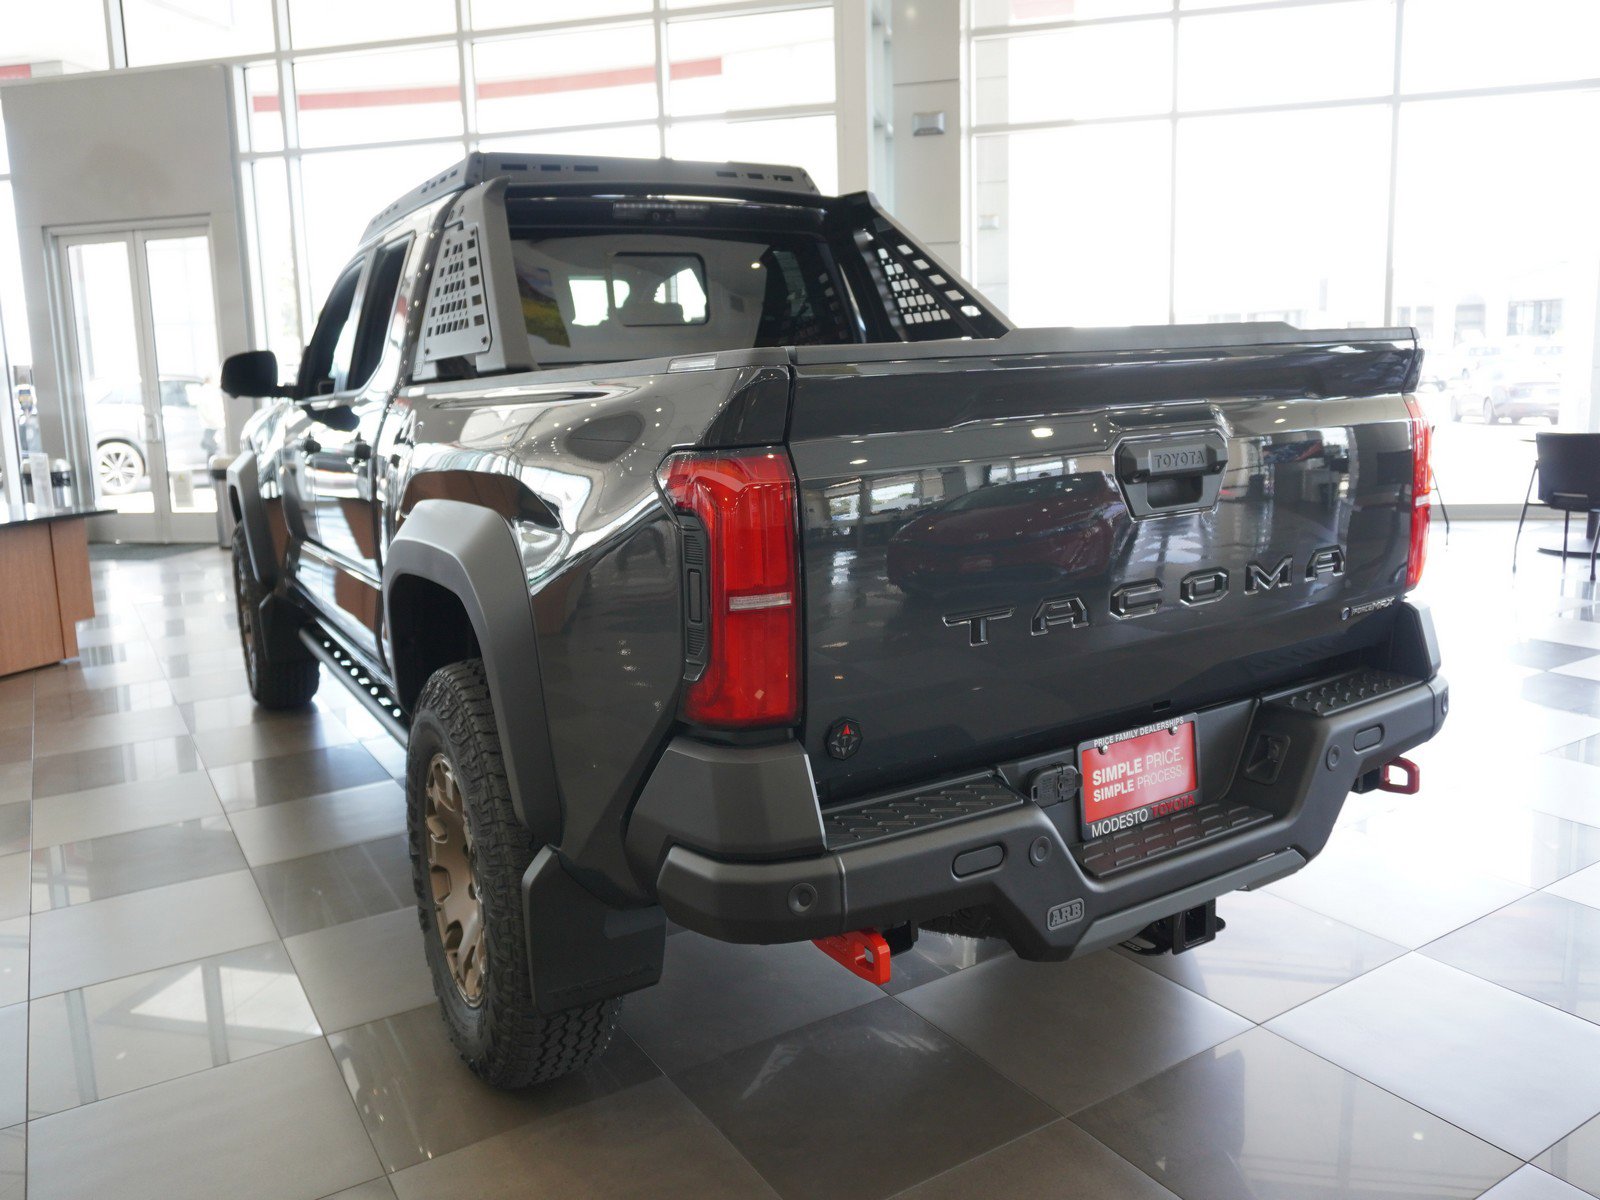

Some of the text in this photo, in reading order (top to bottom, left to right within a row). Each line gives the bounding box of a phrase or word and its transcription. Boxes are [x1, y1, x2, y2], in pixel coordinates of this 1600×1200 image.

[1153, 450, 1205, 469] TOYOTA
[941, 544, 1347, 648] TACOMA
[1093, 717, 1184, 748] PRICE FAMILY DEALERSHIPS
[1092, 757, 1143, 786] SIMPLE
[1145, 746, 1184, 770] PRICE.
[1093, 779, 1135, 803] SIMPLE
[1137, 765, 1184, 789] PROCESS.
[1091, 794, 1195, 839] MODESTO TOYOTA
[1050, 903, 1082, 927] ARB
